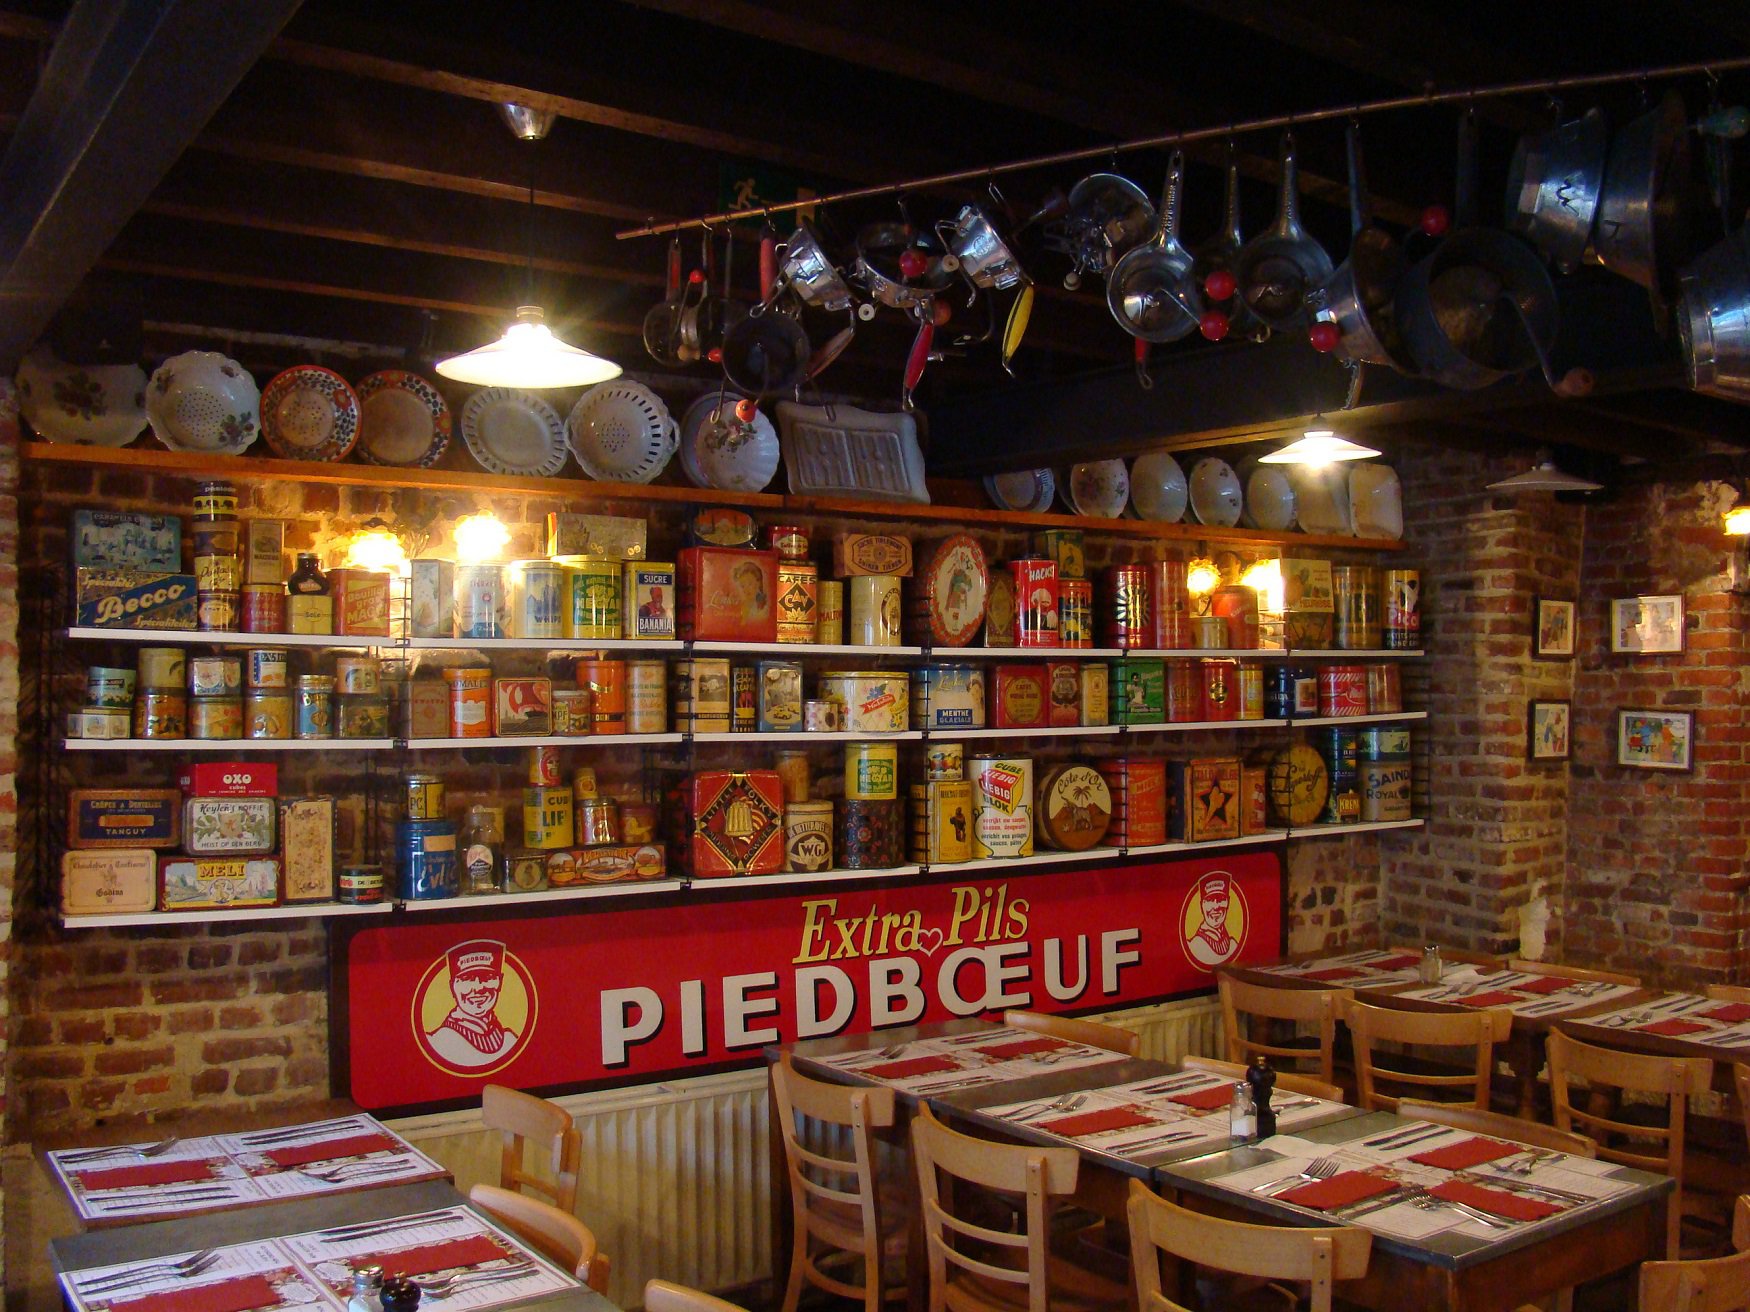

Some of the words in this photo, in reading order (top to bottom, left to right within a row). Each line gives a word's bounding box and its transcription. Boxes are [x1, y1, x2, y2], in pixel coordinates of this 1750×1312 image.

[643, 574, 668, 584] SUCRE
[93, 584, 187, 624] Becco
[639, 617, 672, 630] BANANIA
[942, 709, 969, 717] MENTHE
[995, 762, 1023, 775] CUBE
[223, 773, 252, 784] OXO
[984, 769, 1017, 784] LIEBIG
[707, 787, 734, 820] LITTLE
[199, 863, 246, 878] MELI
[791, 898, 923, 965] Extra
[942, 882, 1030, 946] Pils
[600, 928, 1140, 1068] PIEDBŒUF
